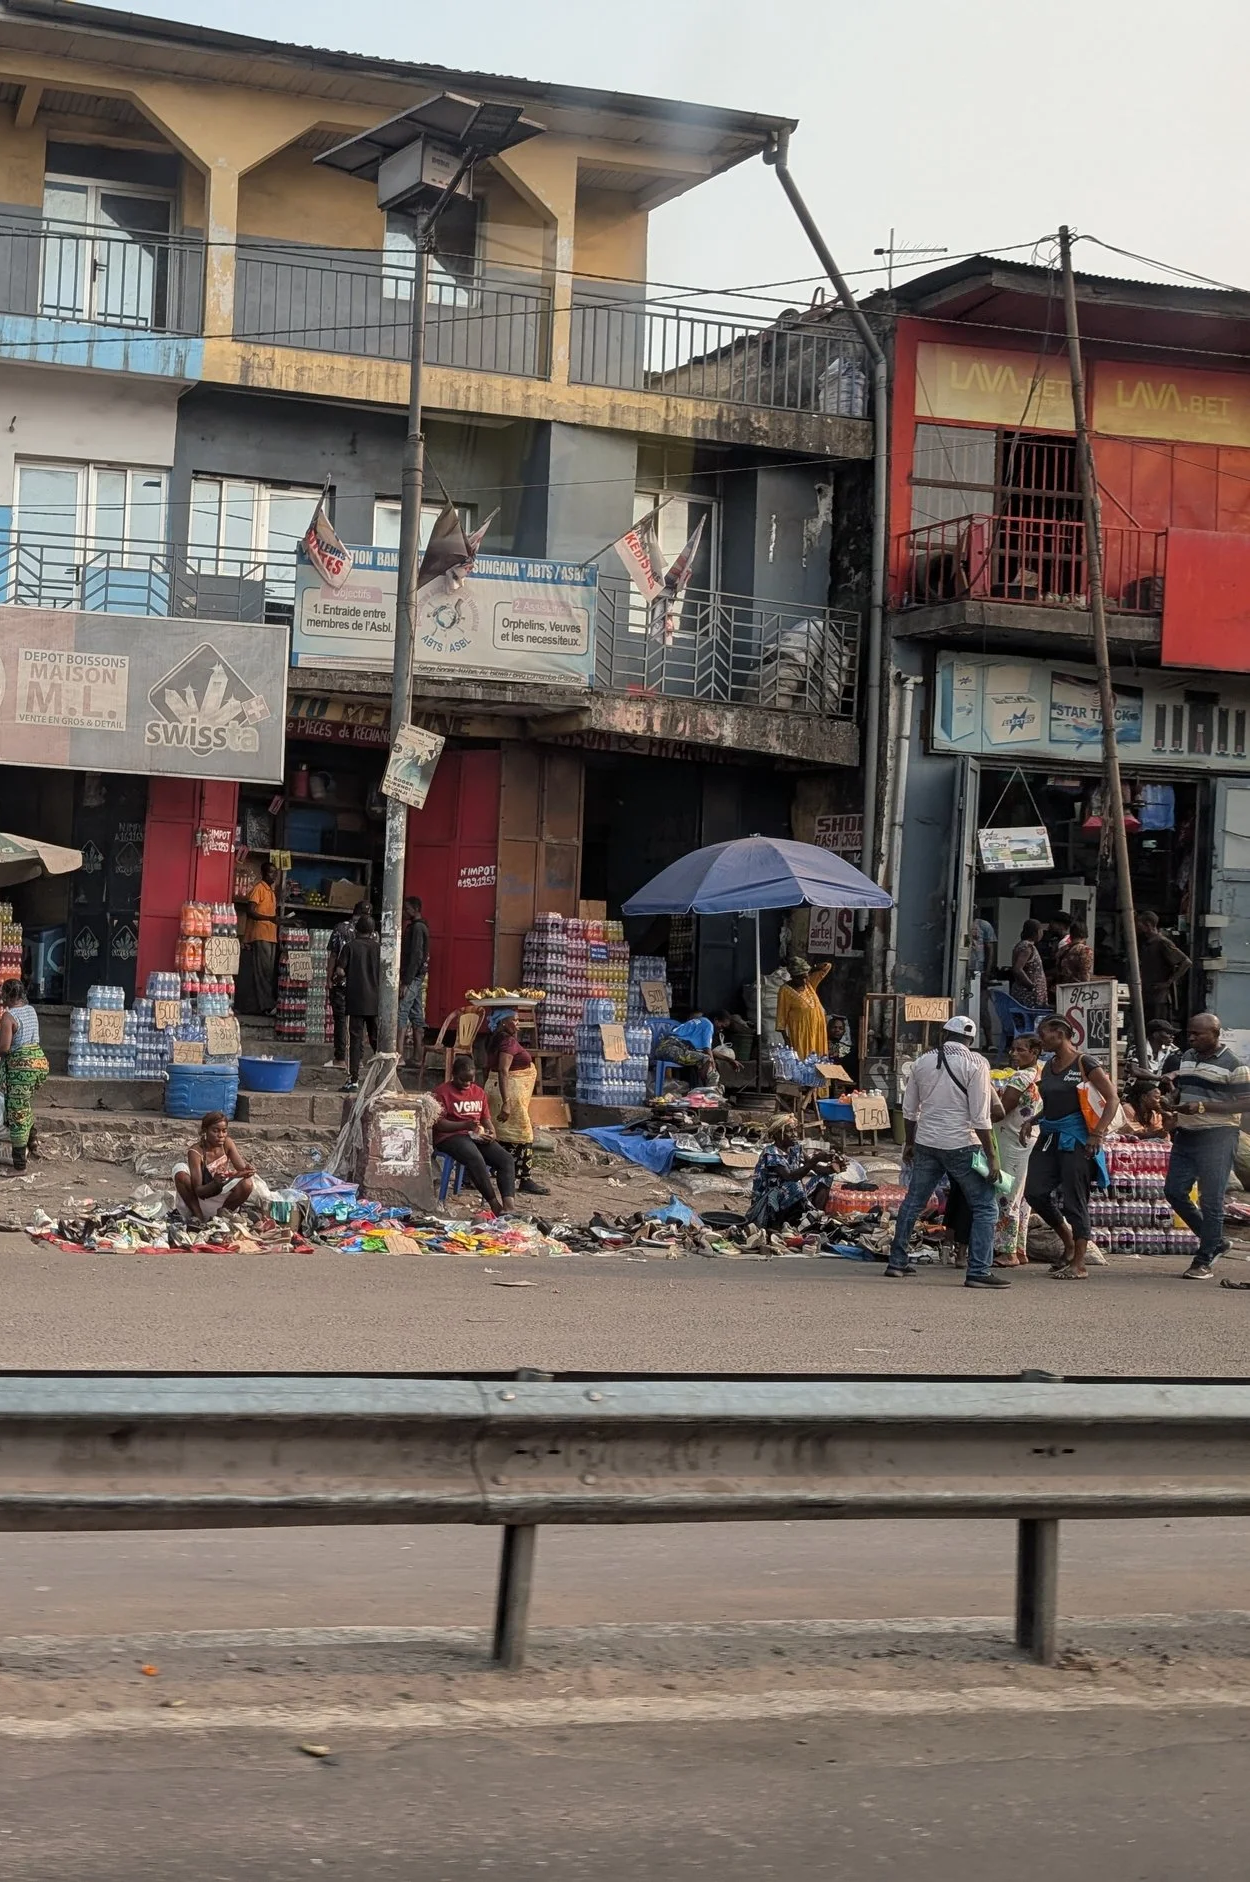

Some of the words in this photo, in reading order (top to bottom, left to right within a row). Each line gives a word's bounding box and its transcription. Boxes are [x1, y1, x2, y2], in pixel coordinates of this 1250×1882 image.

[1116, 380, 1232, 416] LAVA.BET
[313, 603, 321, 615] 1.
[322, 604, 362, 617] Entraide
[362, 609, 387, 619] entre
[306, 617, 350, 630] membres
[351, 620, 363, 631] de
[502, 617, 548, 632] Orphelins,
[549, 621, 581, 634] Veuves
[421, 635, 443, 653] ABTS
[449, 636, 472, 653] ASBL
[500, 633, 510, 642] et
[511, 632, 524, 643] les
[526, 634, 581, 647] necessiteux.
[24, 650, 65, 664] DEPOT
[67, 653, 127, 669] BOISSONS
[30, 663, 117, 686] MAISON
[25, 680, 117, 720] M.L.
[19, 713, 48, 725] VENTE
[48, 715, 61, 725] EN
[61, 716, 86, 727] GROS
[86, 718, 94, 728] &
[94, 719, 125, 730] DETAIL
[1056, 706, 1087, 718] STAR
[1090, 708, 1130, 721] TCK
[145, 717, 260, 753] swissta
[297, 719, 333, 738] PIECES
[338, 727, 350, 739] de
[384, 783, 408, 796] KALONJI
[394, 776, 414, 787] ROGER
[817, 818, 862, 833] SHO
[810, 926, 833, 940] airtel
[836, 907, 852, 955] $
[1069, 987, 1100, 1007] Shop
